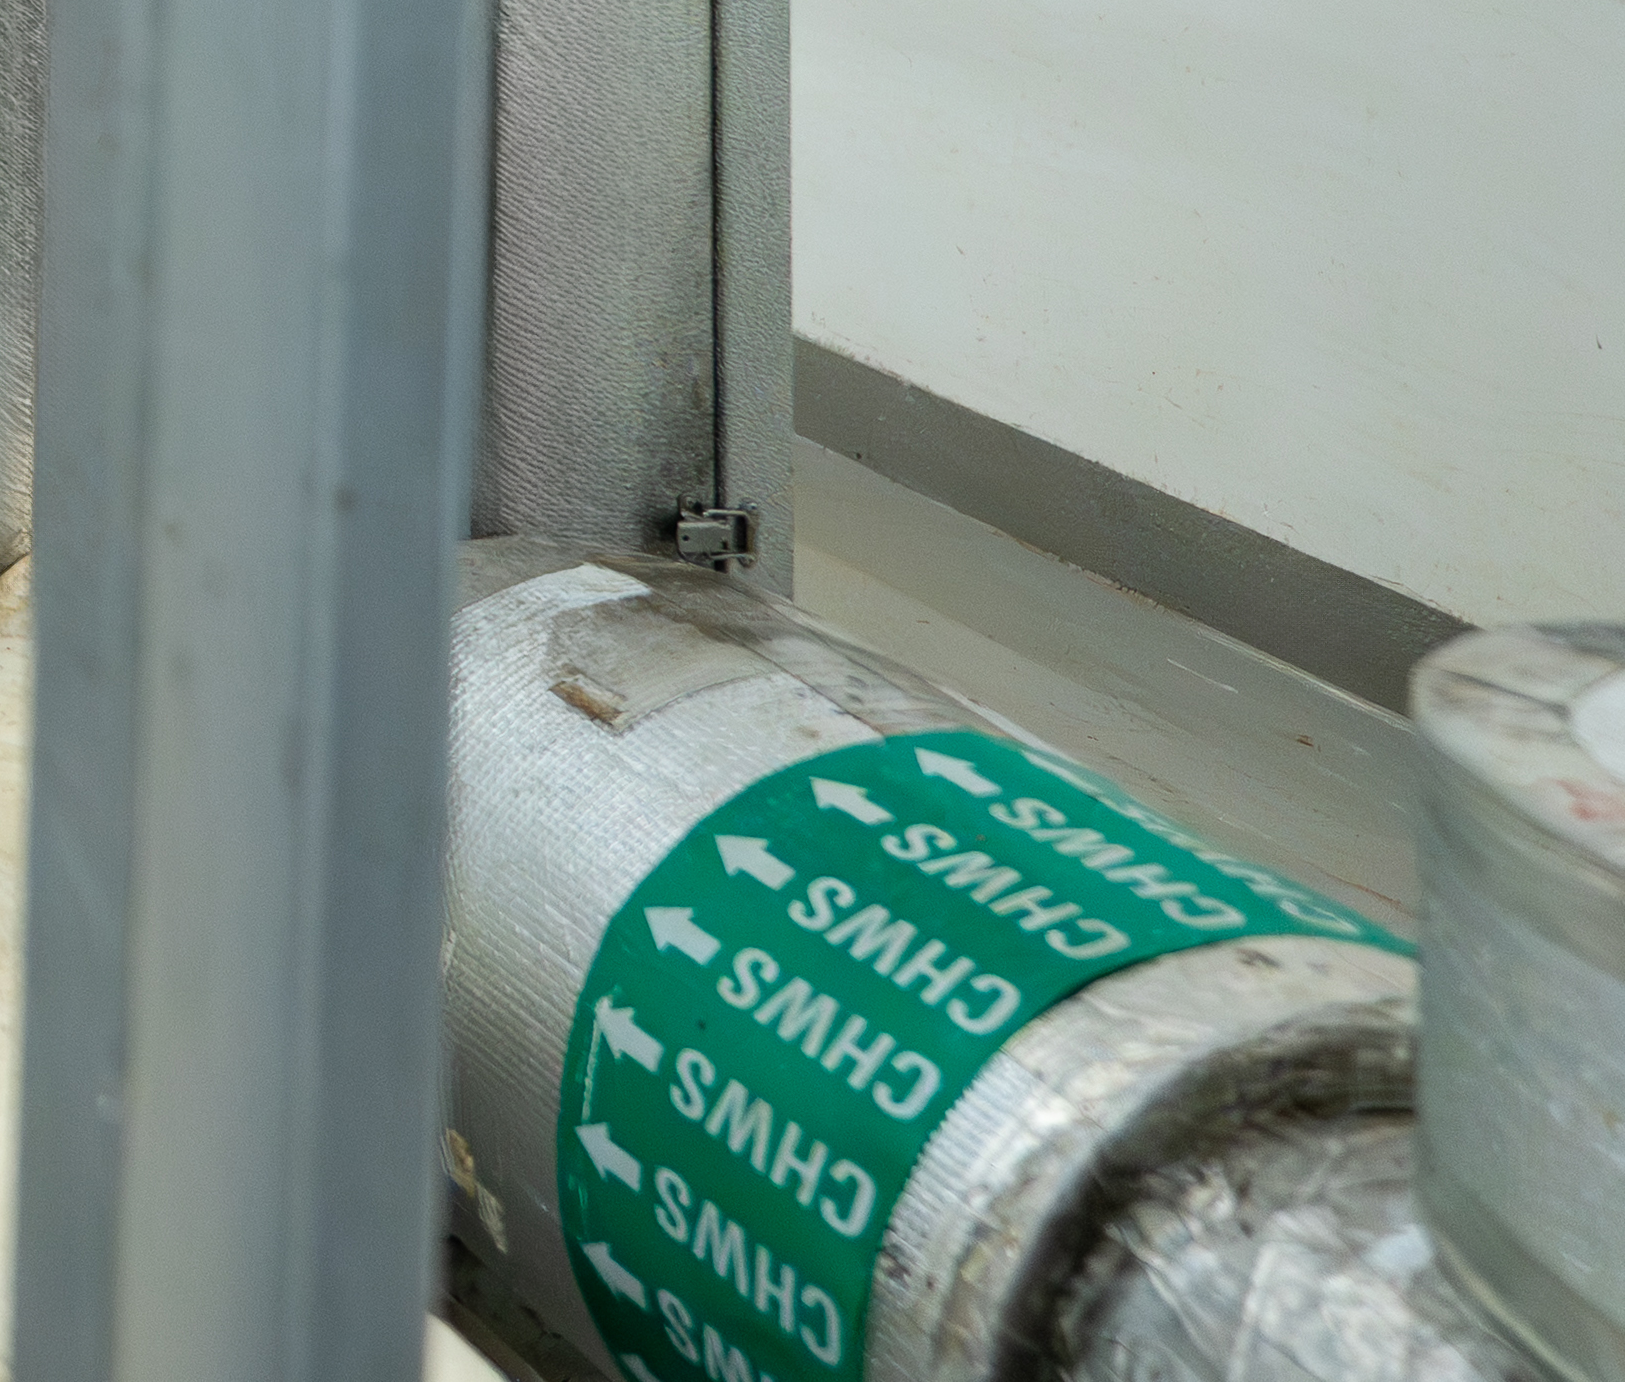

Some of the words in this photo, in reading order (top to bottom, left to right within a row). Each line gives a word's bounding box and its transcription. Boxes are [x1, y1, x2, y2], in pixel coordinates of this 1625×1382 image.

[881, 823, 1131, 960] CHWS
[989, 797, 1247, 930] CHWS
[716, 947, 941, 1120] CHWS
[788, 876, 1022, 1035] CHWS
[669, 1047, 877, 1238] CHWS
[654, 1165, 841, 1366] CHWS
